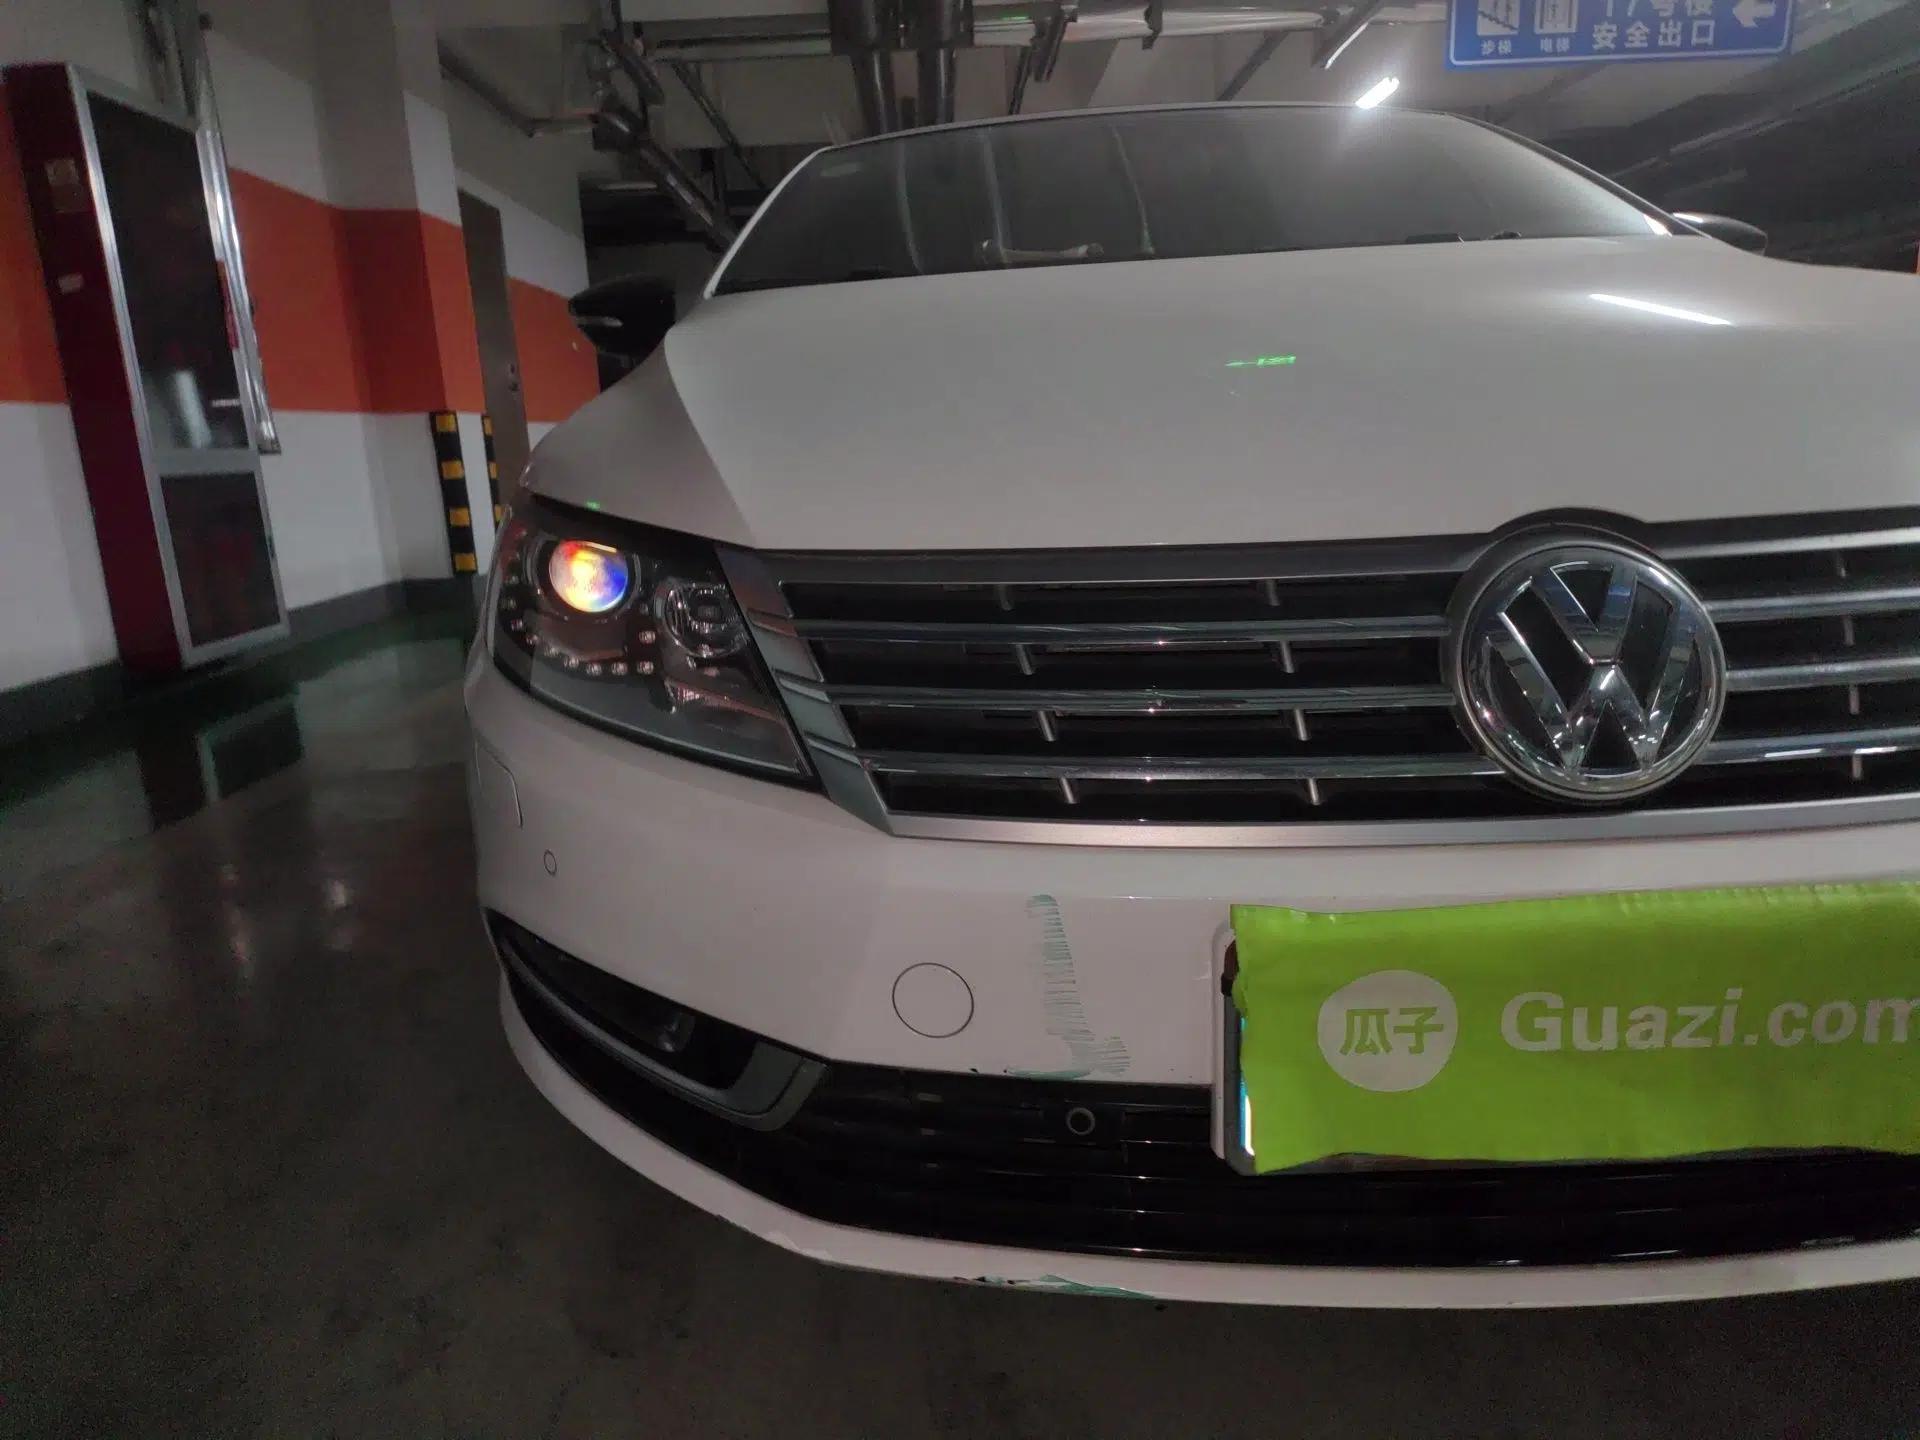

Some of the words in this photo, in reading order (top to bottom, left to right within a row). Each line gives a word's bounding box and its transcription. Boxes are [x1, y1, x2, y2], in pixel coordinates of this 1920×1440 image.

[1592, 20, 1715, 49] 安全出口
[1339, 1006, 1444, 1056] 瓜子
